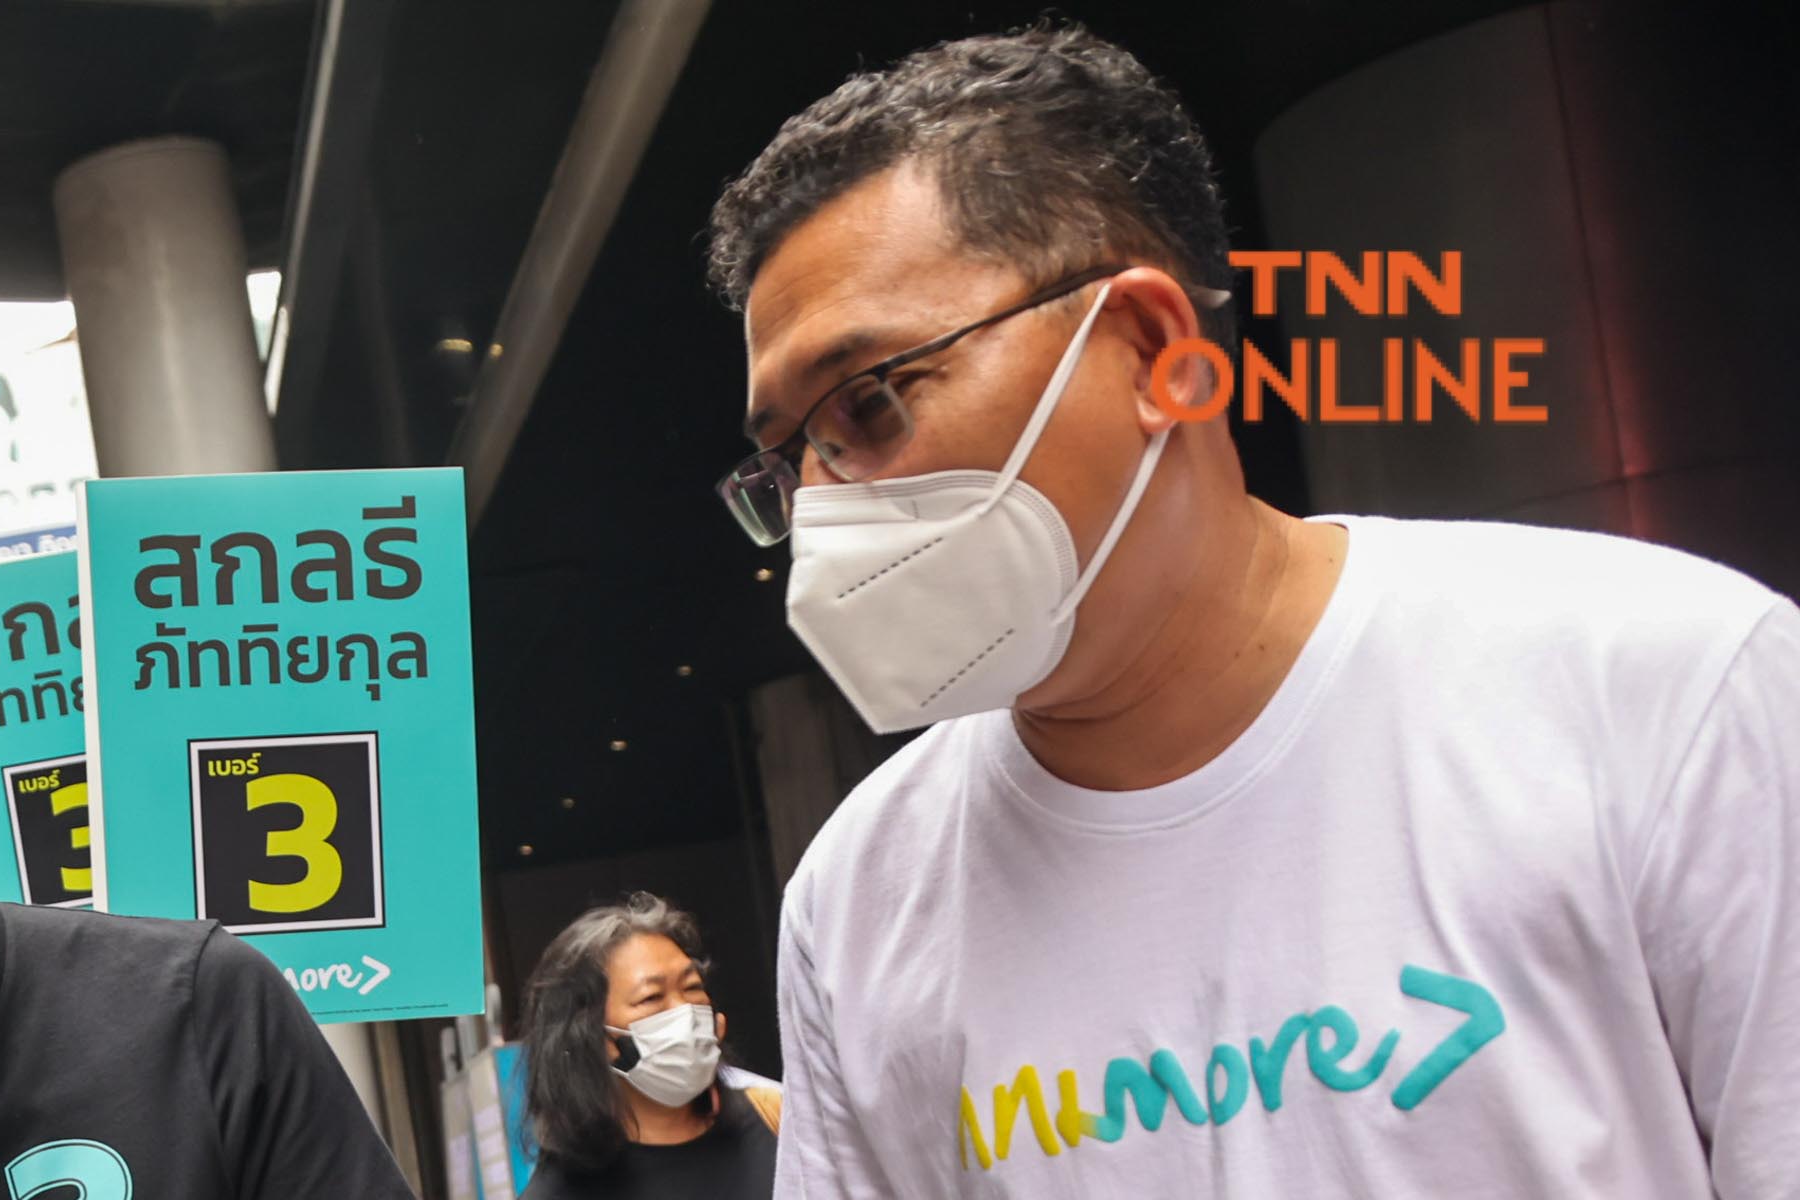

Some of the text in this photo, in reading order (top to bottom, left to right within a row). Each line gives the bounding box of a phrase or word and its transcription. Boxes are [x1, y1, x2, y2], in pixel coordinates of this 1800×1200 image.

[133, 496, 423, 609] สกลธี
[134, 622, 428, 701] ภัททิยกุล
[18, 769, 61, 793] เบอร์
[208, 752, 262, 776] เบอร์
[50, 782, 92, 892] 3
[246, 773, 343, 913] 3
